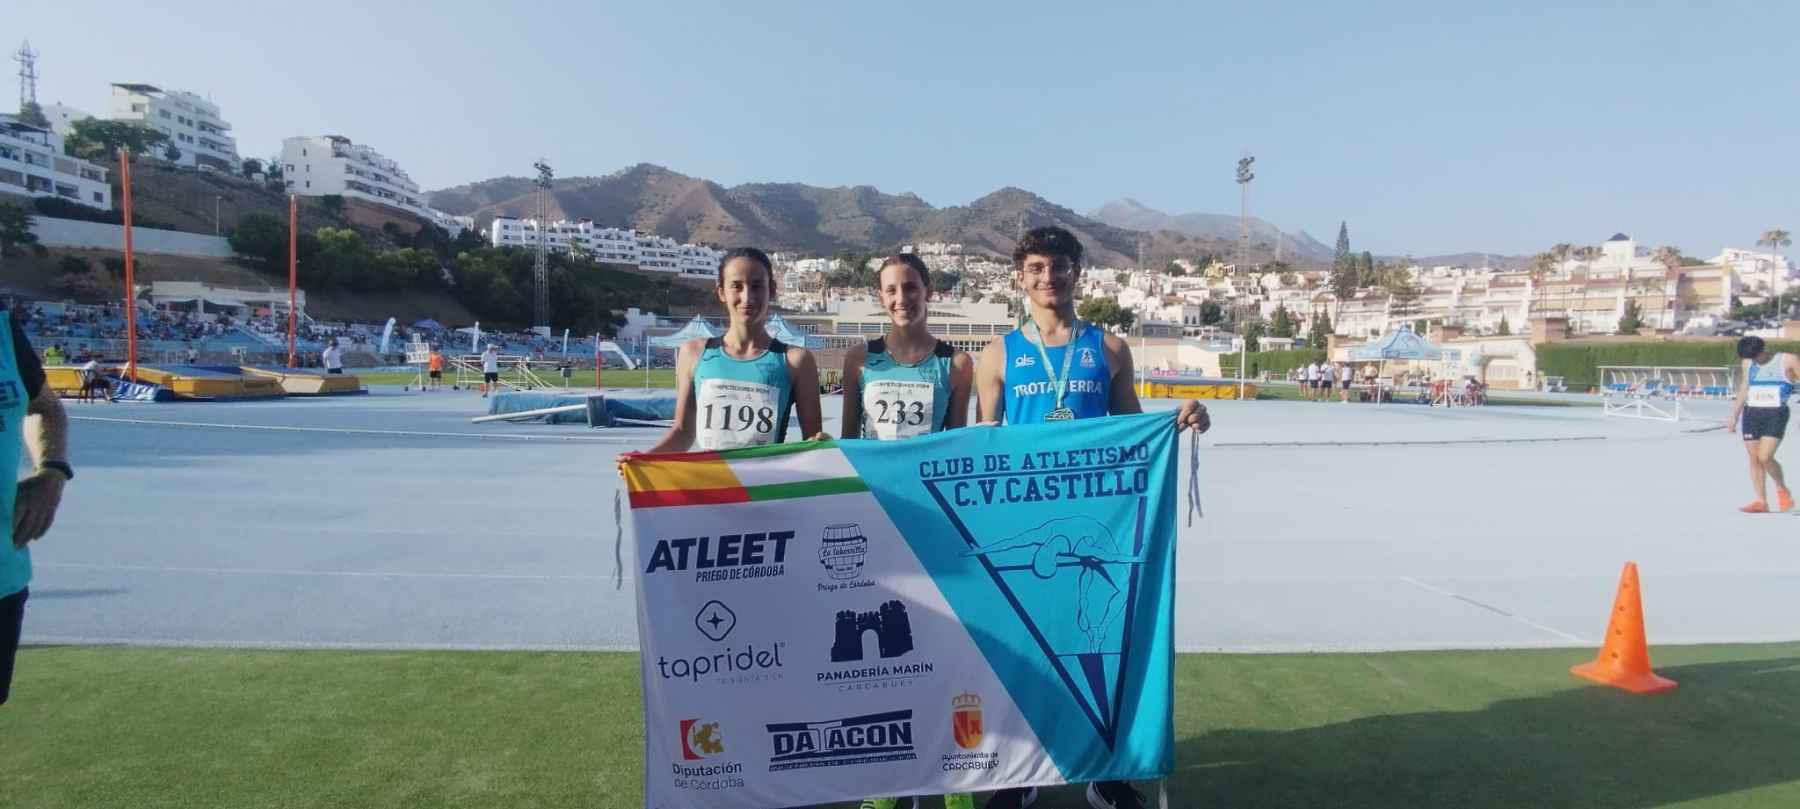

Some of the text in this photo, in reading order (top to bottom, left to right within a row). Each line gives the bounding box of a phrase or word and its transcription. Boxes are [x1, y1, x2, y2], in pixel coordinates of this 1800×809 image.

[704, 404, 773, 433] 1198
[875, 400, 924, 425] 233
[920, 443, 1149, 478] CLUB DE ATLETISMO
[646, 530, 795, 573] ATLEET
[696, 568, 728, 583] PRIEGO
[730, 567, 741, 580] DE
[817, 662, 933, 681] PANADERÍA MARÍN
[773, 721, 913, 755] DATACON
[672, 762, 742, 778] Diputación
[943, 760, 1000, 771] CARCABUEY
[674, 779, 688, 789] de
